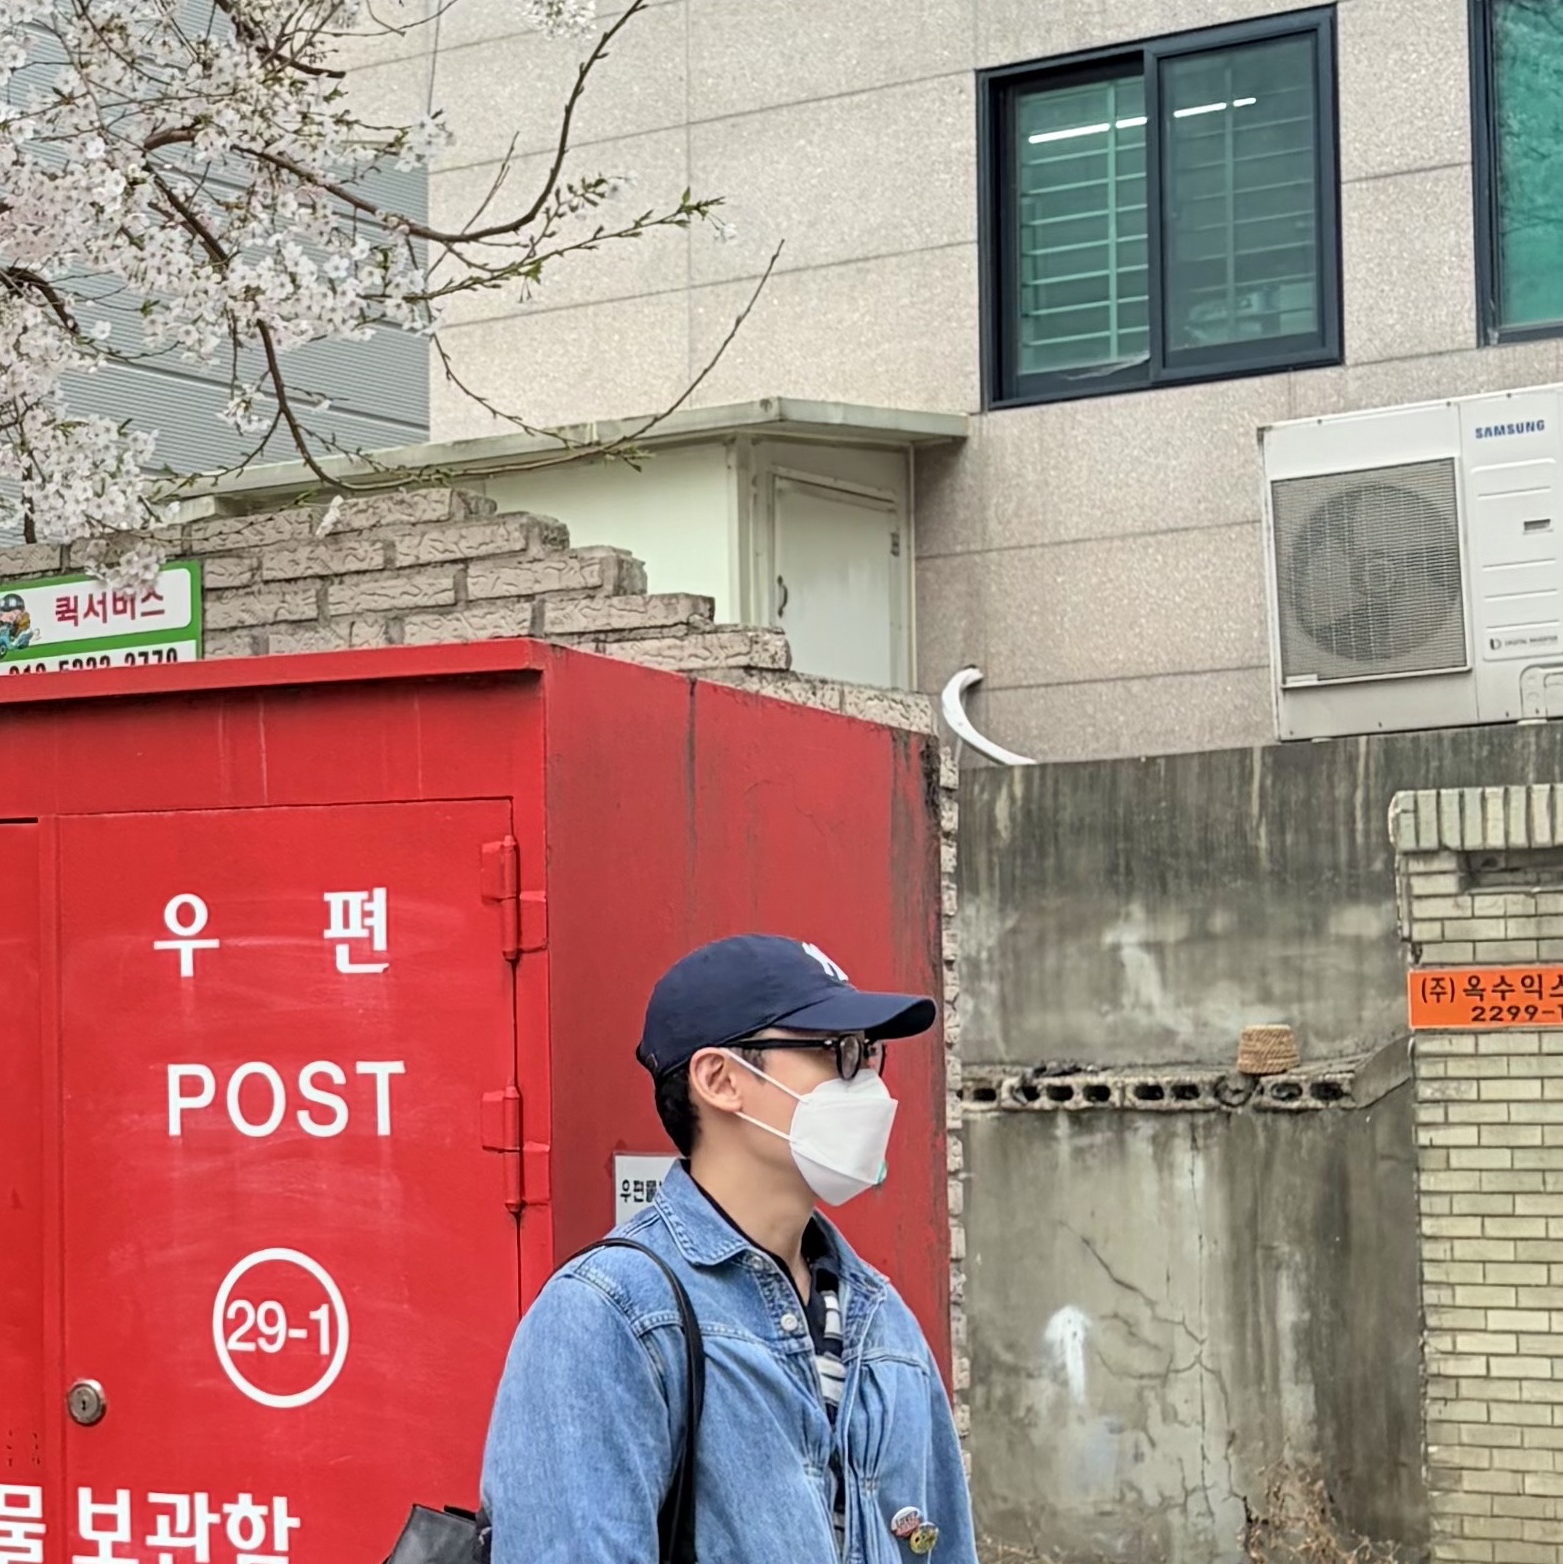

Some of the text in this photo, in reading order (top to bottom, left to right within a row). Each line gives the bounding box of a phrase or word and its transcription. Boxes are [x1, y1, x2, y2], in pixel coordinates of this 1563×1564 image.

[1475, 419, 1545, 439] SAMSUNG
[55, 584, 165, 626] 퀵서비스
[168, 1061, 406, 1138] POST
[226, 1300, 331, 1357] 29-1
